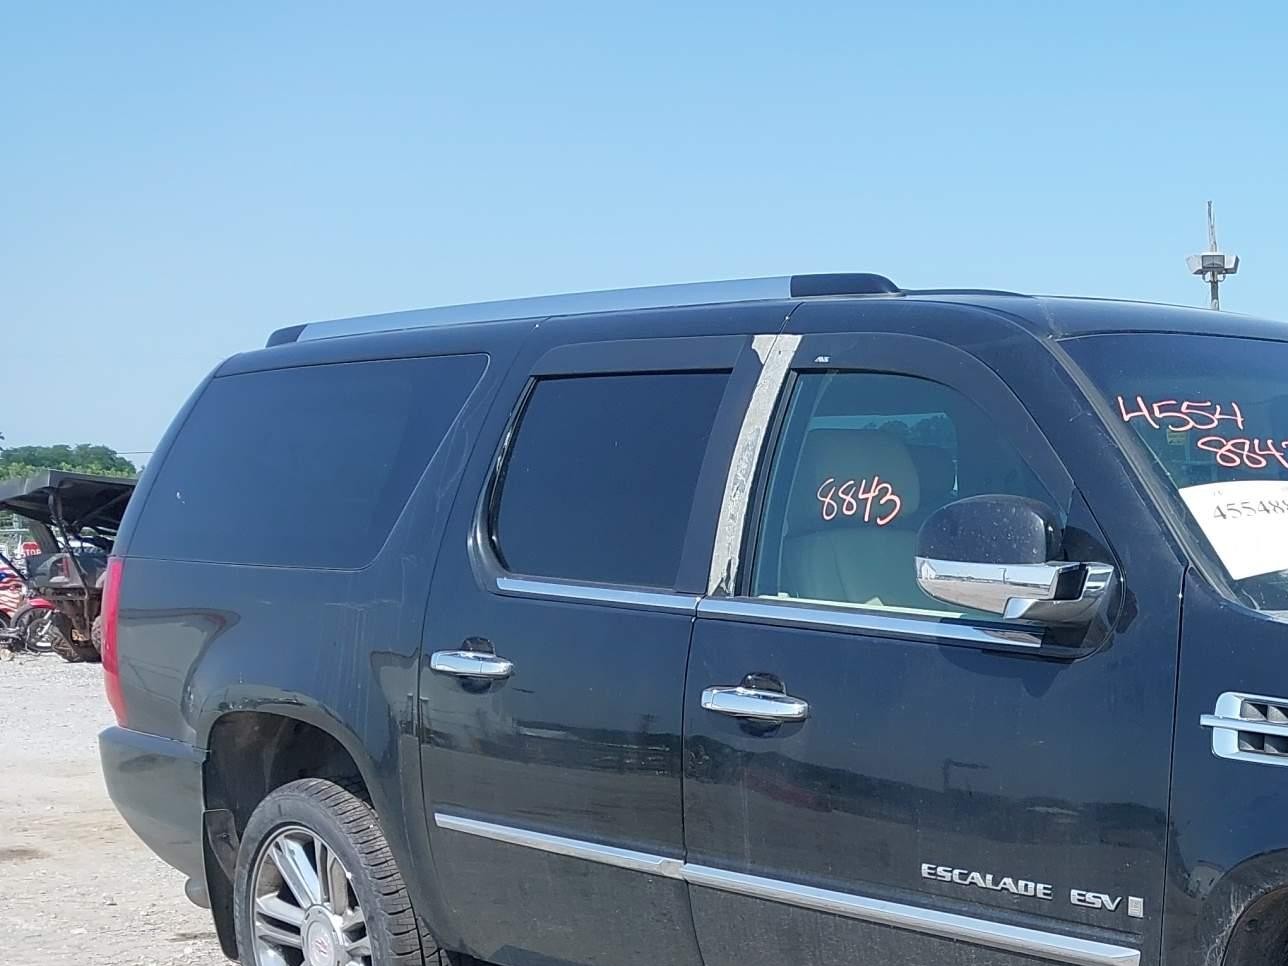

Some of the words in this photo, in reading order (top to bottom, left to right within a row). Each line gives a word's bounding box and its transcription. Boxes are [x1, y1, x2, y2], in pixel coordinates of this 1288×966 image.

[1117, 396, 1245, 431] 4554
[816, 476, 901, 525] 8843
[921, 863, 1053, 900] ESCALADE
[1070, 888, 1122, 911] ESV
